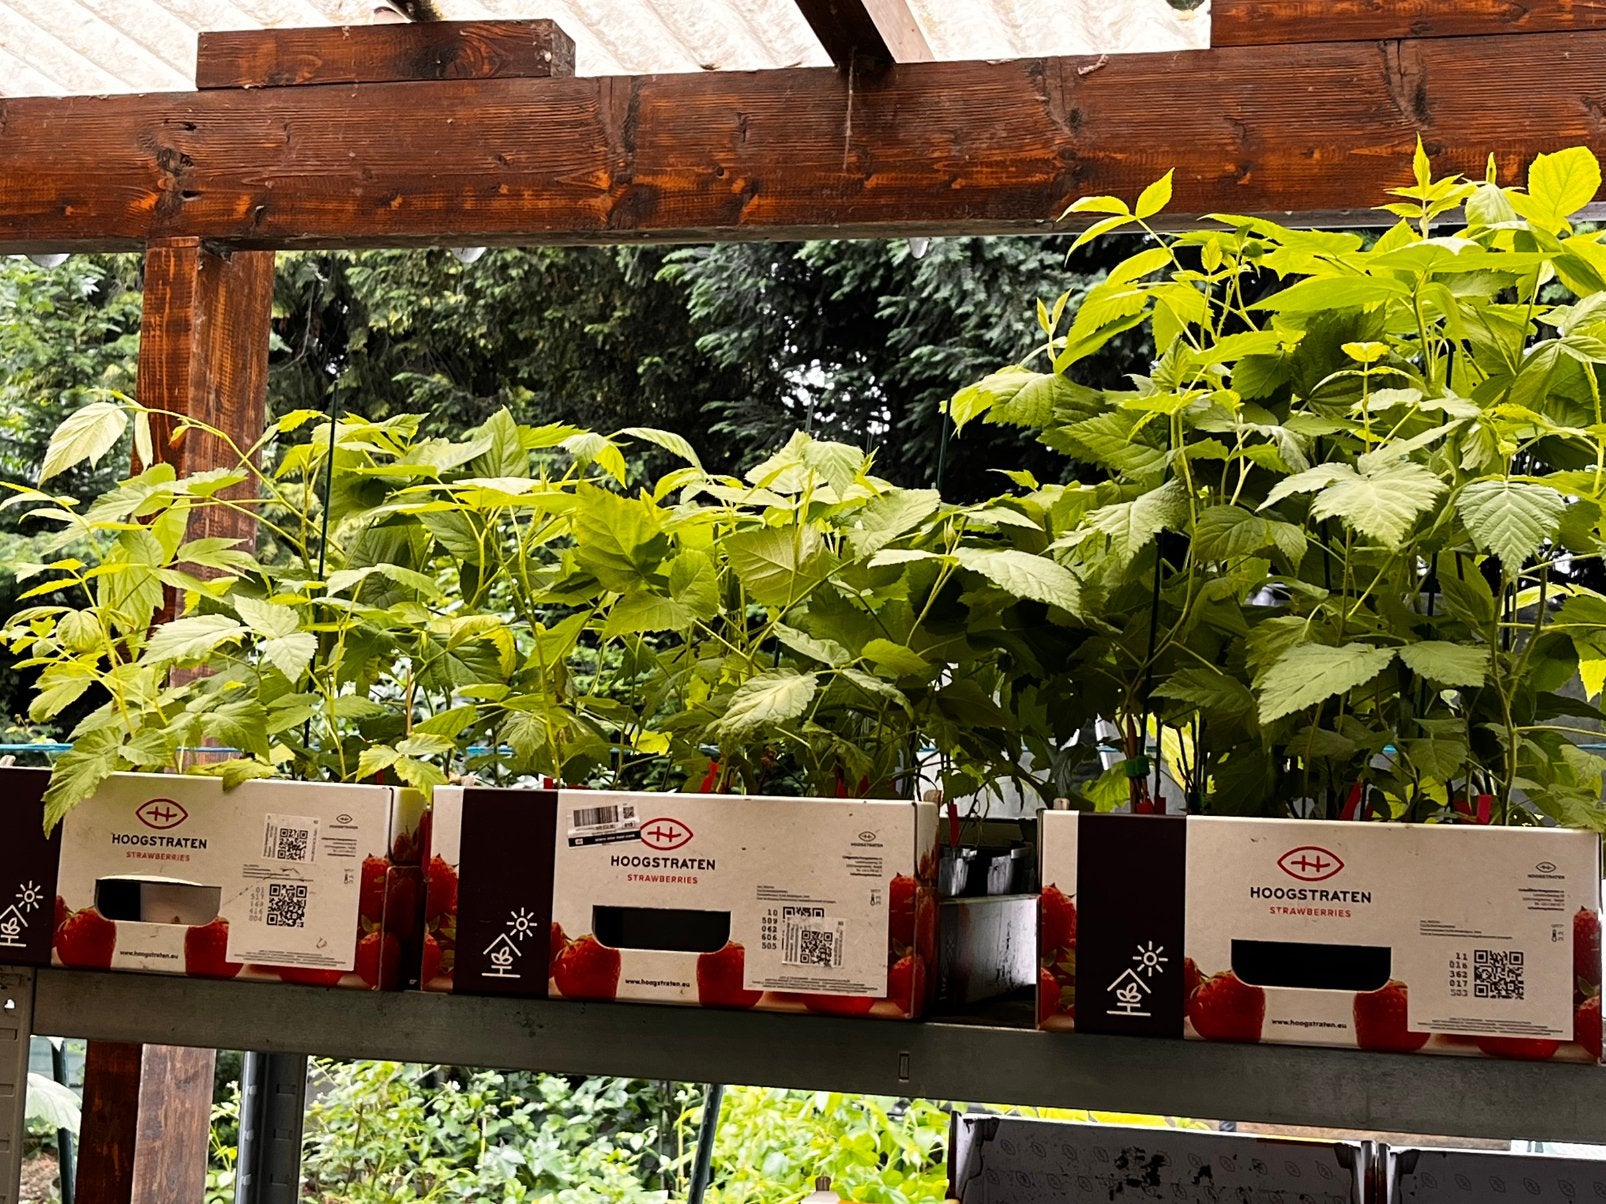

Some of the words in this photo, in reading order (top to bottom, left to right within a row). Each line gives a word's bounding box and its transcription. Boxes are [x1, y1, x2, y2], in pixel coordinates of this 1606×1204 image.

[112, 833, 207, 849] HOOGSTRATEN
[126, 851, 190, 862] STRAWBERRIES
[610, 855, 716, 871] HOOGSTRATEN
[627, 873, 698, 885] STRAWBERRIES
[1250, 886, 1371, 903] HOOGSTRATEN
[1269, 906, 1351, 918] STRAWBERRIES
[1456, 952, 1468, 961] 11
[1449, 970, 1468, 978] 362
[1449, 979, 1468, 988] 017
[1271, 1019, 1348, 1029] www.hoogstraten.eu
